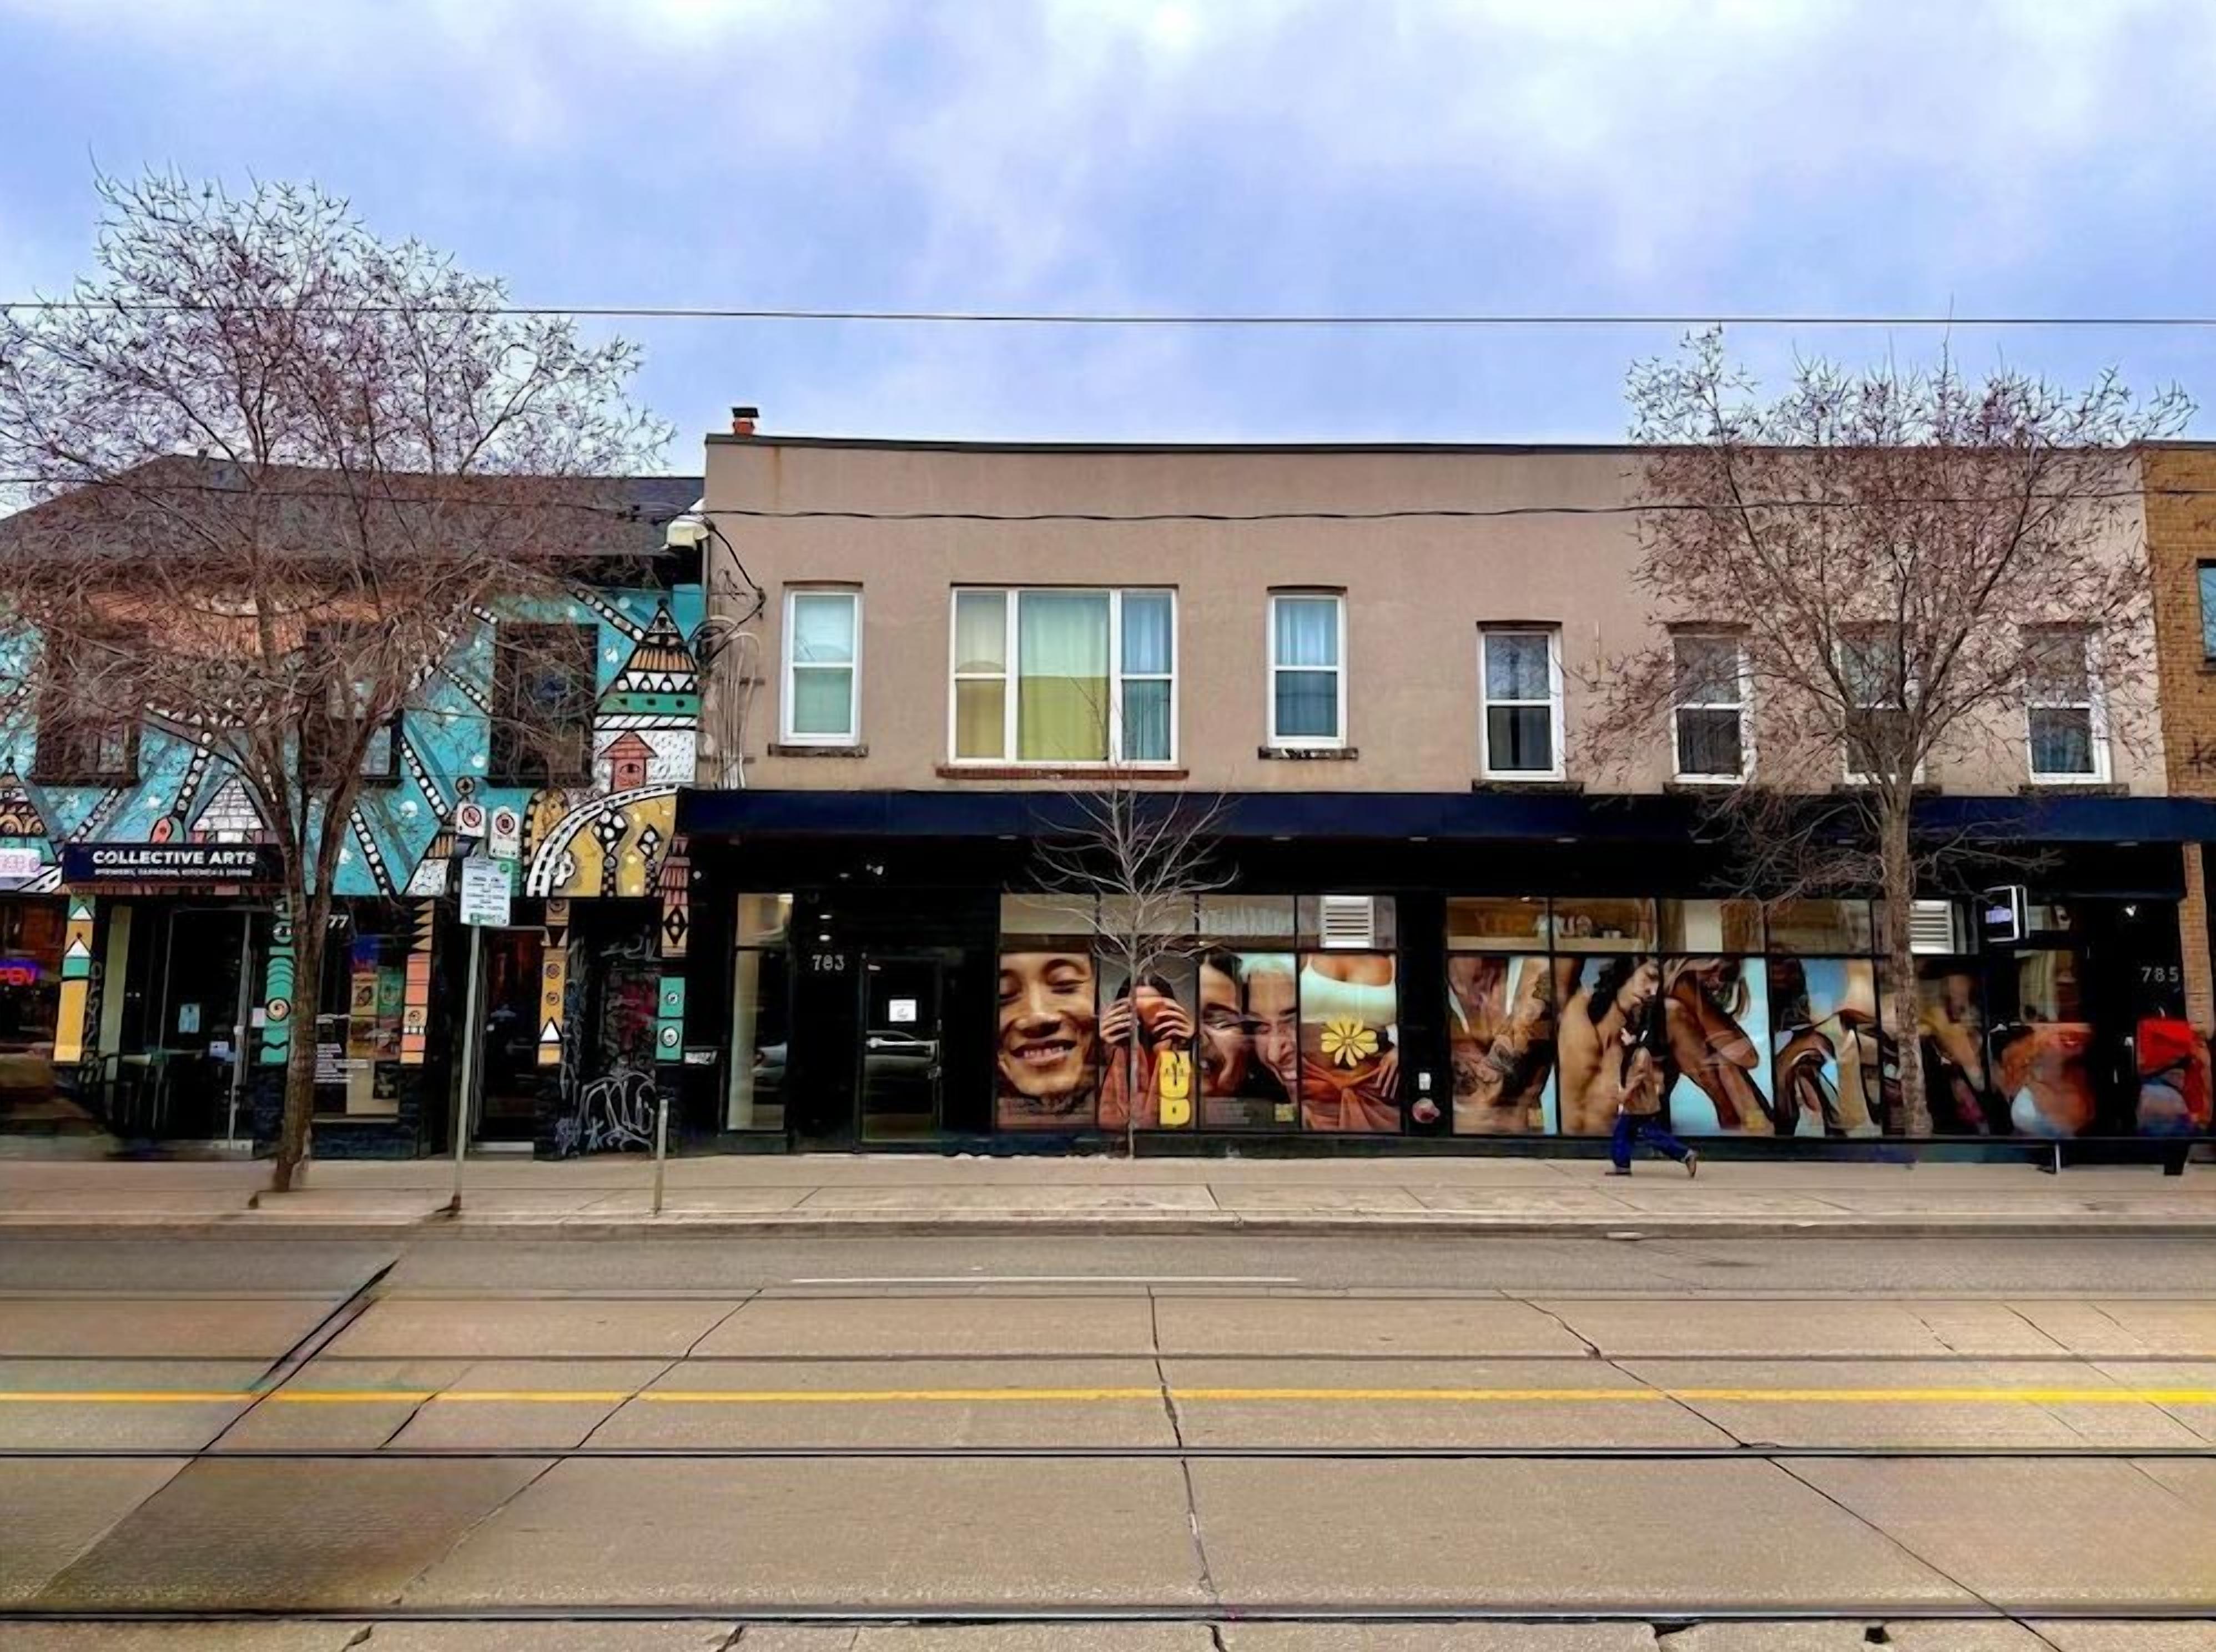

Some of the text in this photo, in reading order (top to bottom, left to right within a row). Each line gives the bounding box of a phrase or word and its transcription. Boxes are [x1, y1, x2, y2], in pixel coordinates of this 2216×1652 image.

[92, 850, 256, 864] COLLECTIVE ARTS
[2141, 966, 2179, 983] 785
